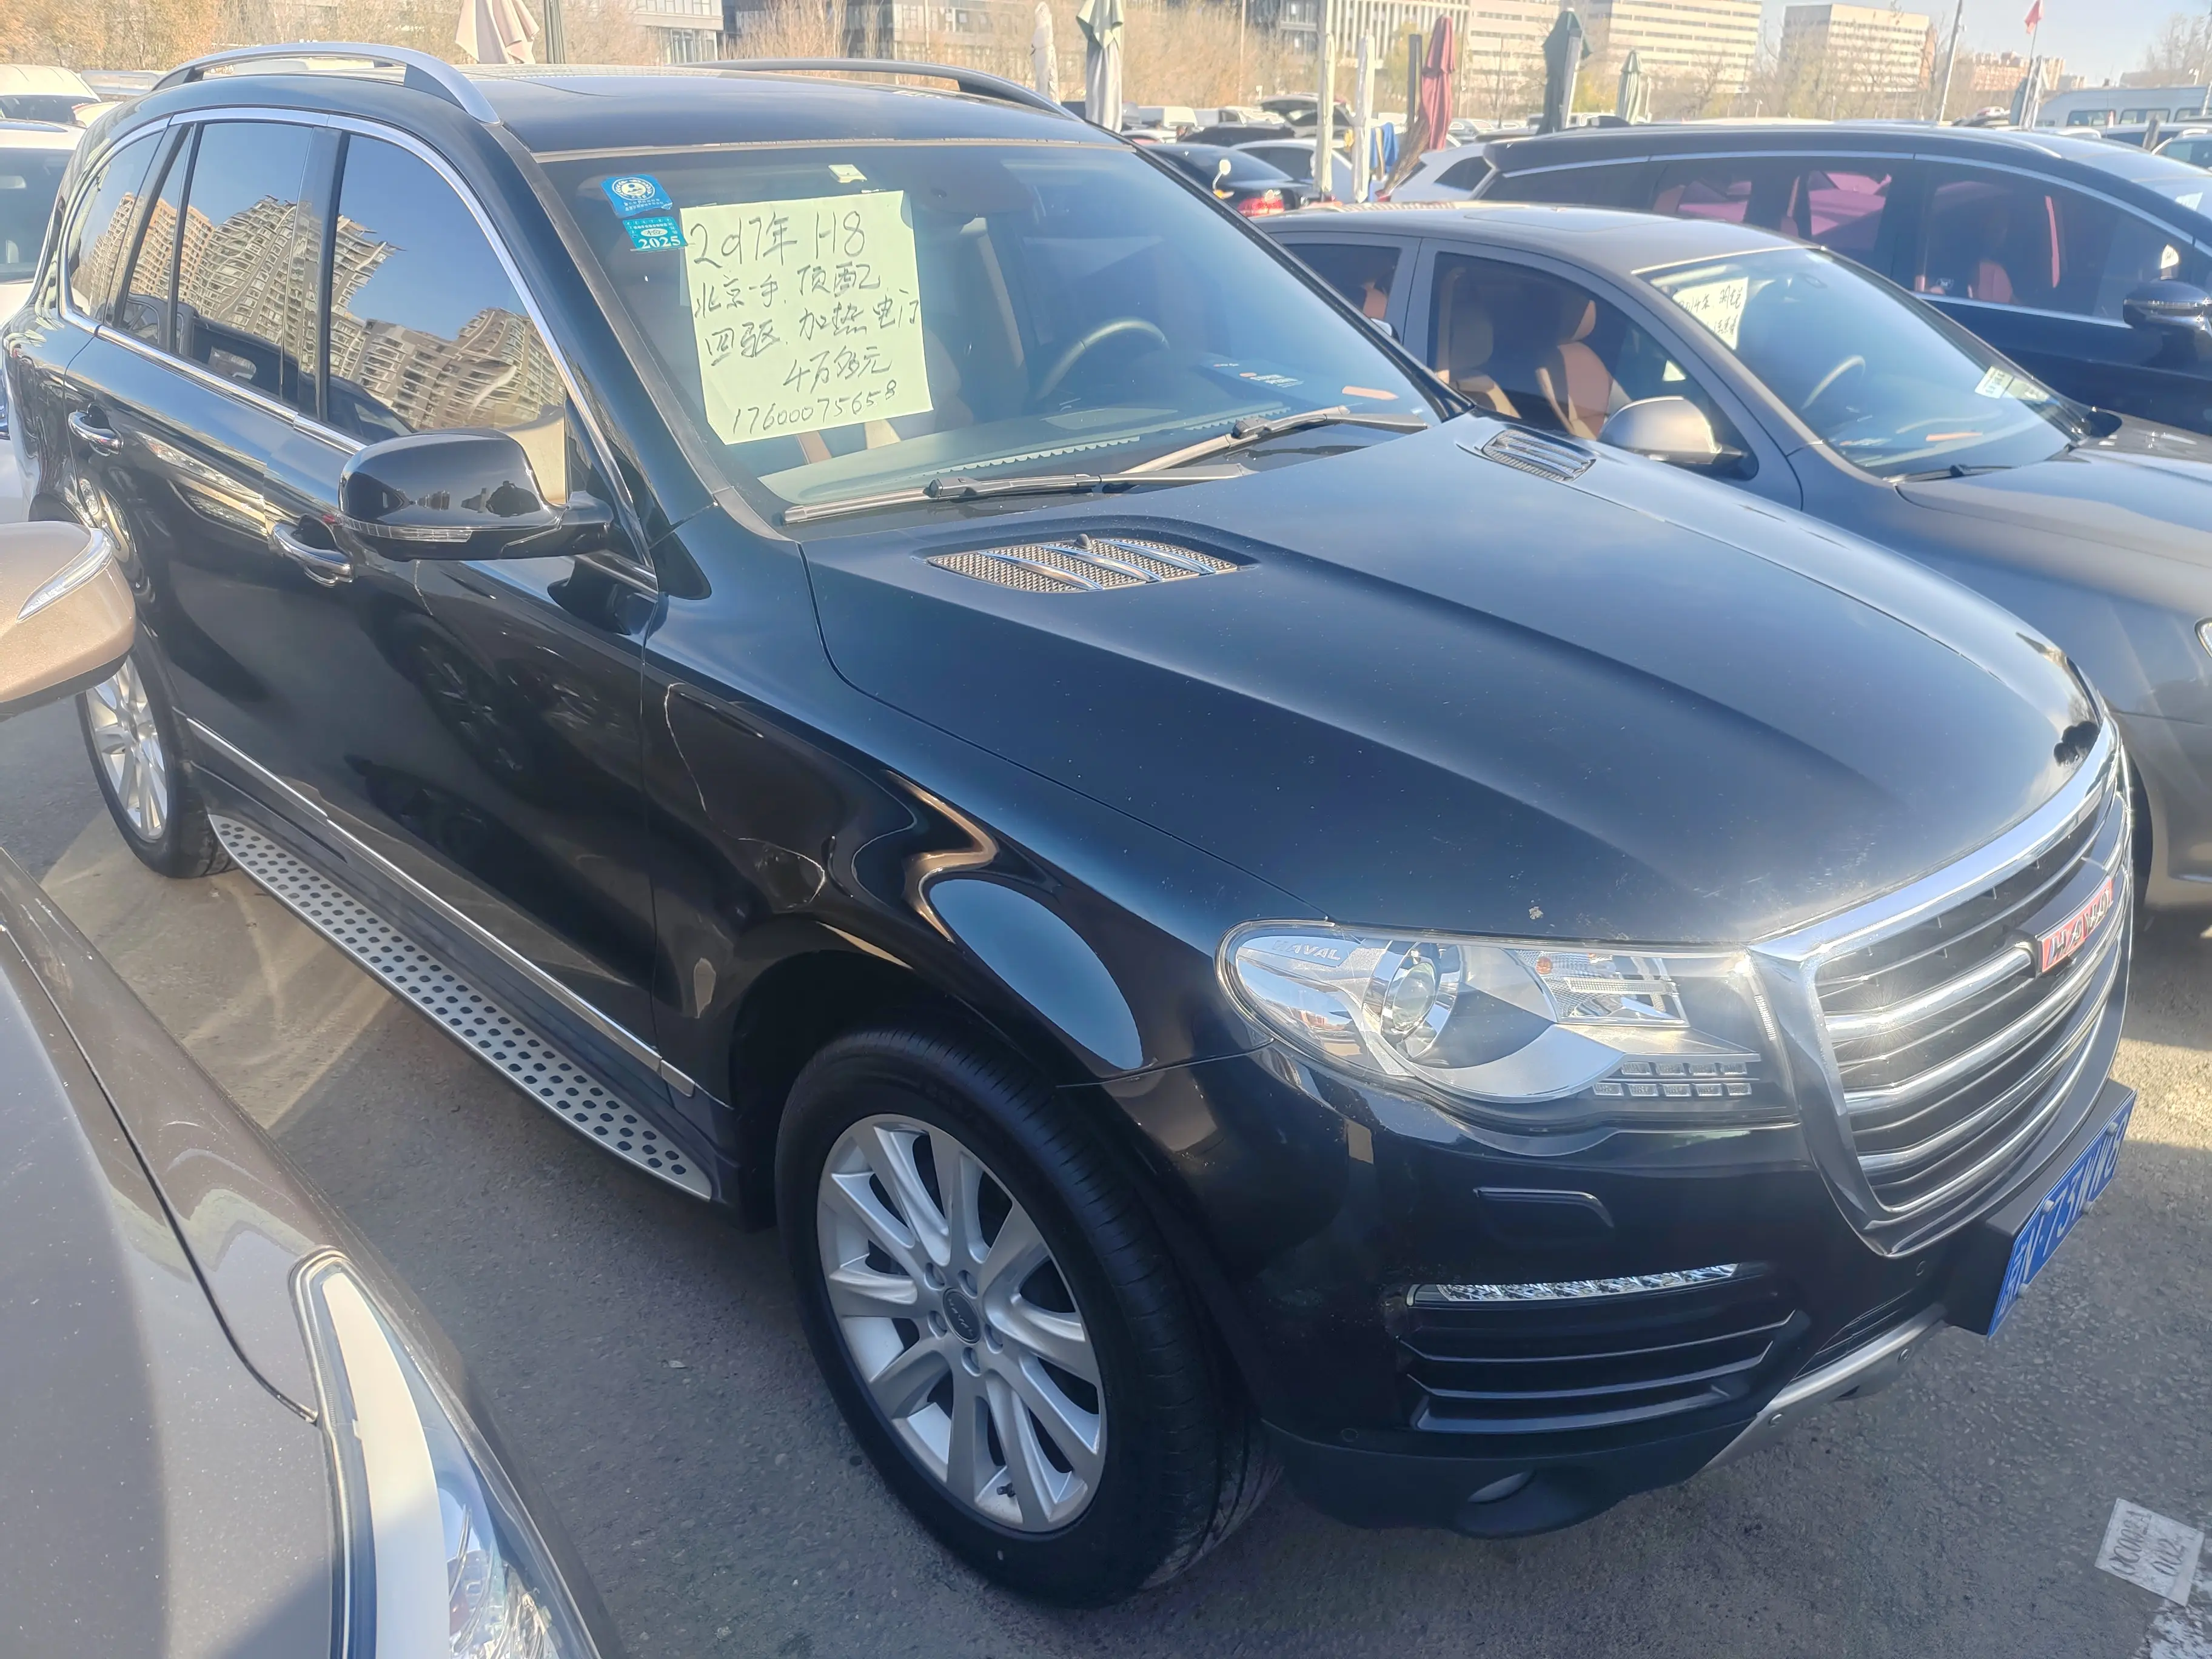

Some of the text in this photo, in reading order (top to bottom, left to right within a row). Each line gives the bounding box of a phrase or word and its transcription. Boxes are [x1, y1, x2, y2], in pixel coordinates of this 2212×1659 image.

[638, 235, 681, 249] 2025
[816, 210, 865, 260] H8
[732, 379, 897, 435] 17600075658
[1272, 940, 1341, 960] HAVAL
